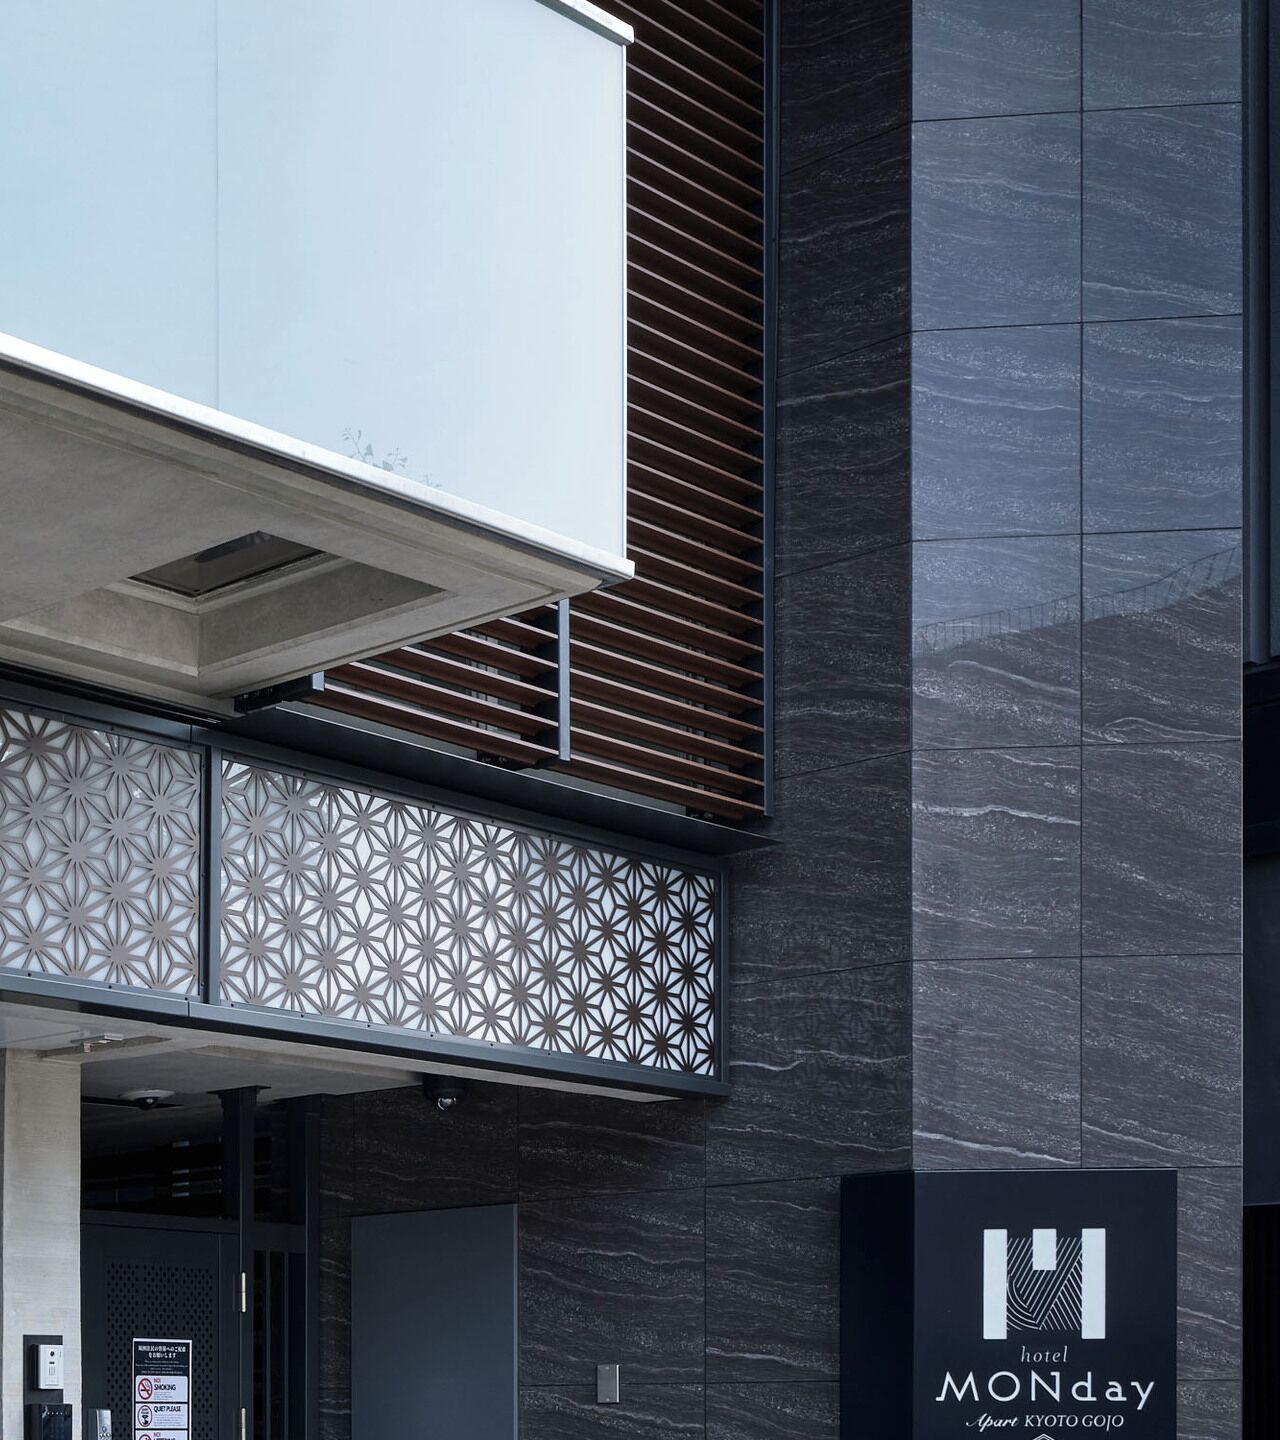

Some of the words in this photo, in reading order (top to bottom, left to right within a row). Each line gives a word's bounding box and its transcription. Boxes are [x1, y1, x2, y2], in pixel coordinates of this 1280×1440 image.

[1020, 1345, 1068, 1363] hotel
[935, 1369, 1156, 1411] MONday
[965, 1412, 1019, 1433] Apart
[1023, 1414, 1079, 1428] KYOTO
[1081, 1414, 1125, 1432] GOJO
